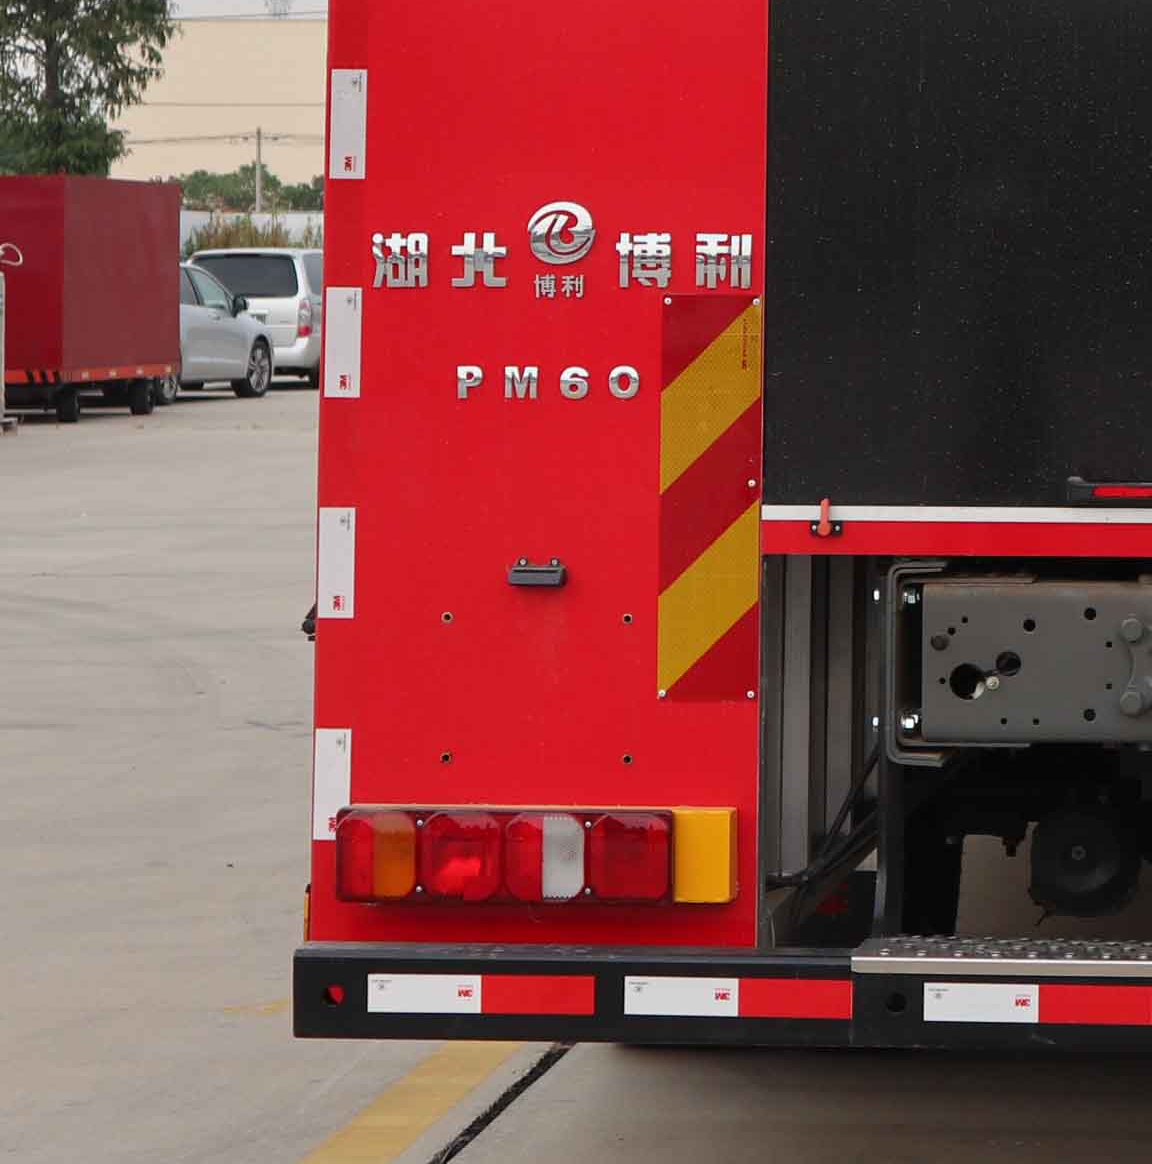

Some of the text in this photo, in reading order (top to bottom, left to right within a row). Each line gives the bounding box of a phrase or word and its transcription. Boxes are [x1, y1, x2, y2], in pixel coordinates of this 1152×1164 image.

[371, 232, 752, 288] 湖北 博利
[533, 274, 584, 298] 博利
